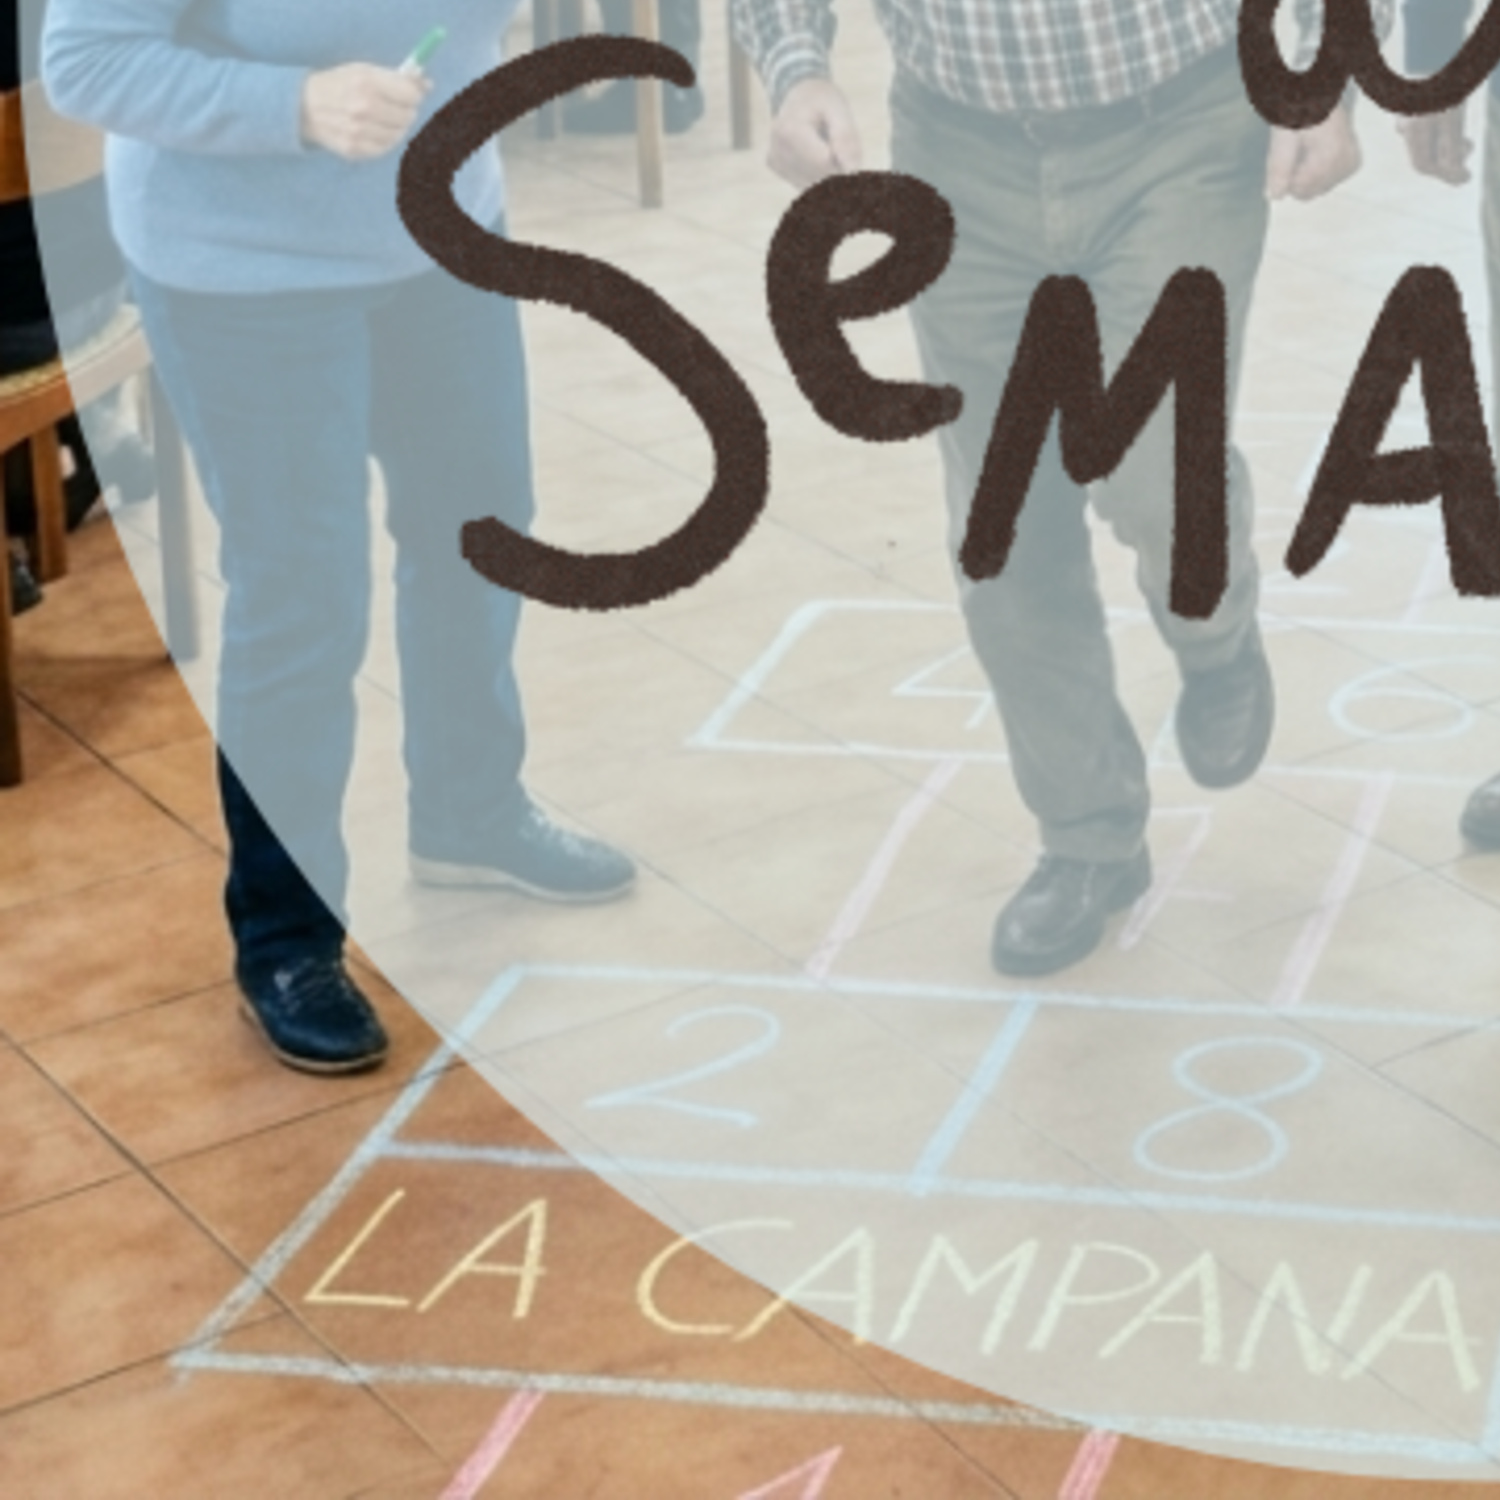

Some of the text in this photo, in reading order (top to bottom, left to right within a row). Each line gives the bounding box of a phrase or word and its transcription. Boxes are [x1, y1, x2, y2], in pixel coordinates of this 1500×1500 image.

[1328, 654, 1500, 741] 6
[585, 1004, 1322, 1181] 2 8
[302, 1187, 1484, 1392] LA CAMPANA
